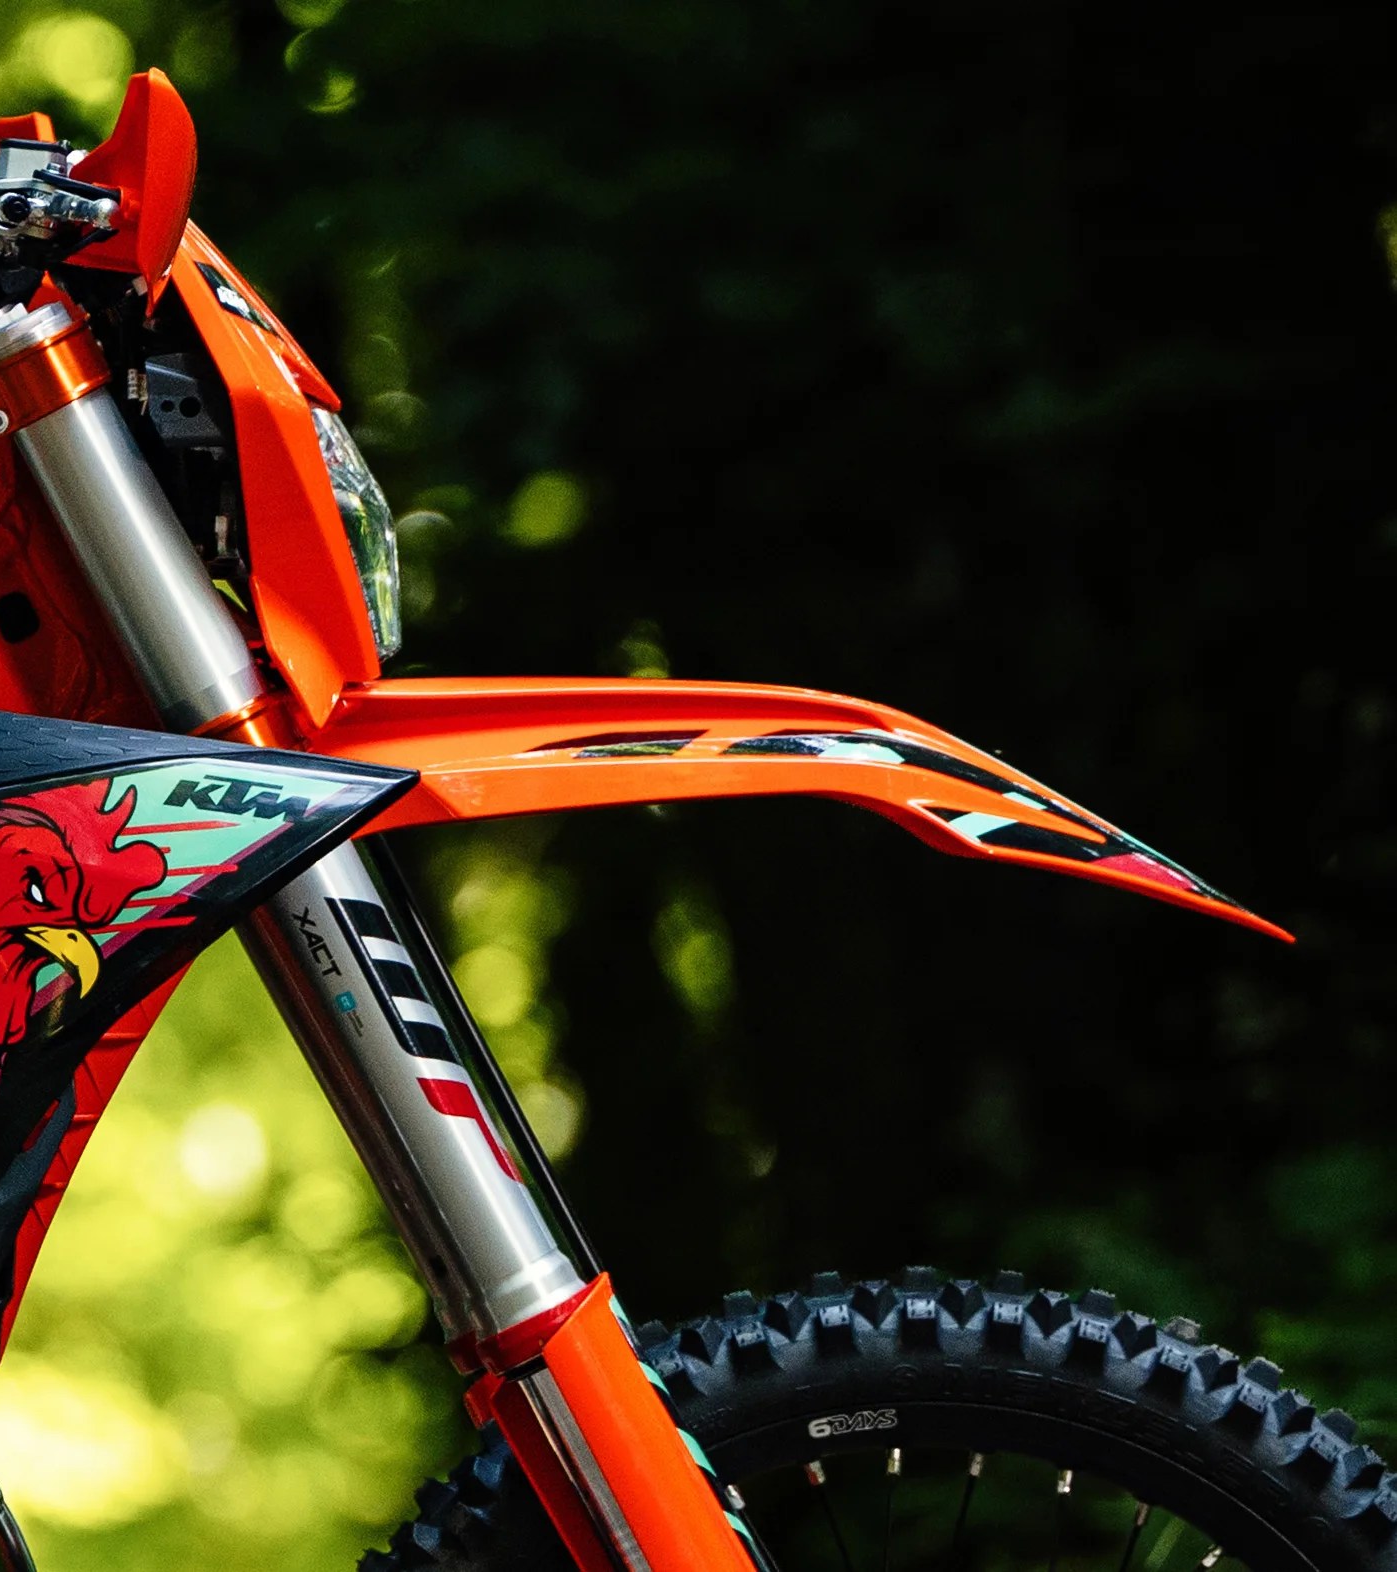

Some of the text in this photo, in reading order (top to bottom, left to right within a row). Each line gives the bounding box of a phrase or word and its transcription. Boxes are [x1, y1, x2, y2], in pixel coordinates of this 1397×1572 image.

[163, 774, 310, 823] KTM
[292, 906, 342, 977] XACT
[808, 1408, 898, 1438] 6DAYS
